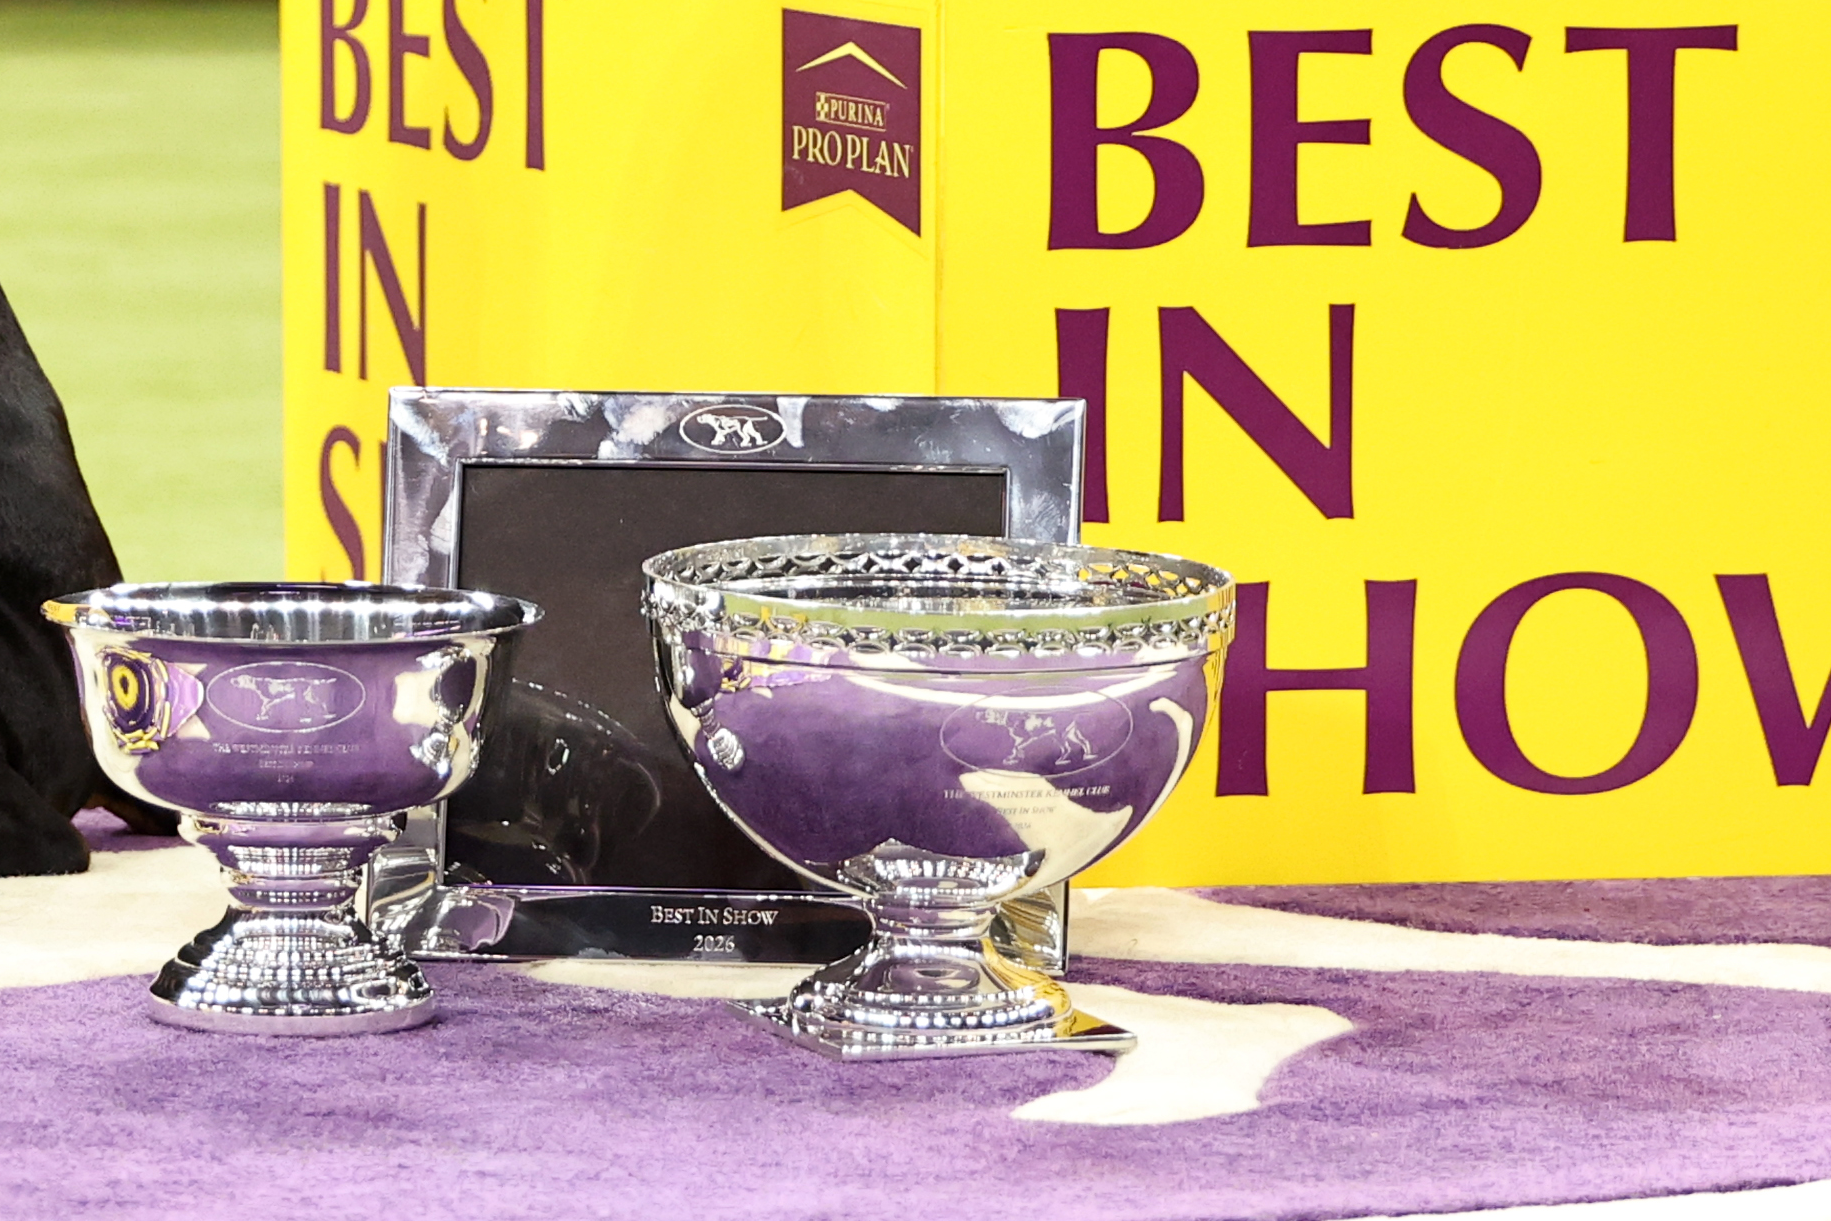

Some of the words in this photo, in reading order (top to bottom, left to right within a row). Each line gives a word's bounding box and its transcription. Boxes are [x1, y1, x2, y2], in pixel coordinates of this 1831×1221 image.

[830, 99, 884, 126] PURINA
[1047, 23, 1738, 251] BEST
[792, 125, 842, 166] PRO
[846, 134, 911, 178] PLAN
[324, 183, 427, 387] IN
[1055, 303, 1356, 524] IN
[650, 905, 694, 925] BEST
[697, 906, 720, 925] IN
[722, 907, 779, 926] SHOW
[693, 934, 736, 953] 2026
